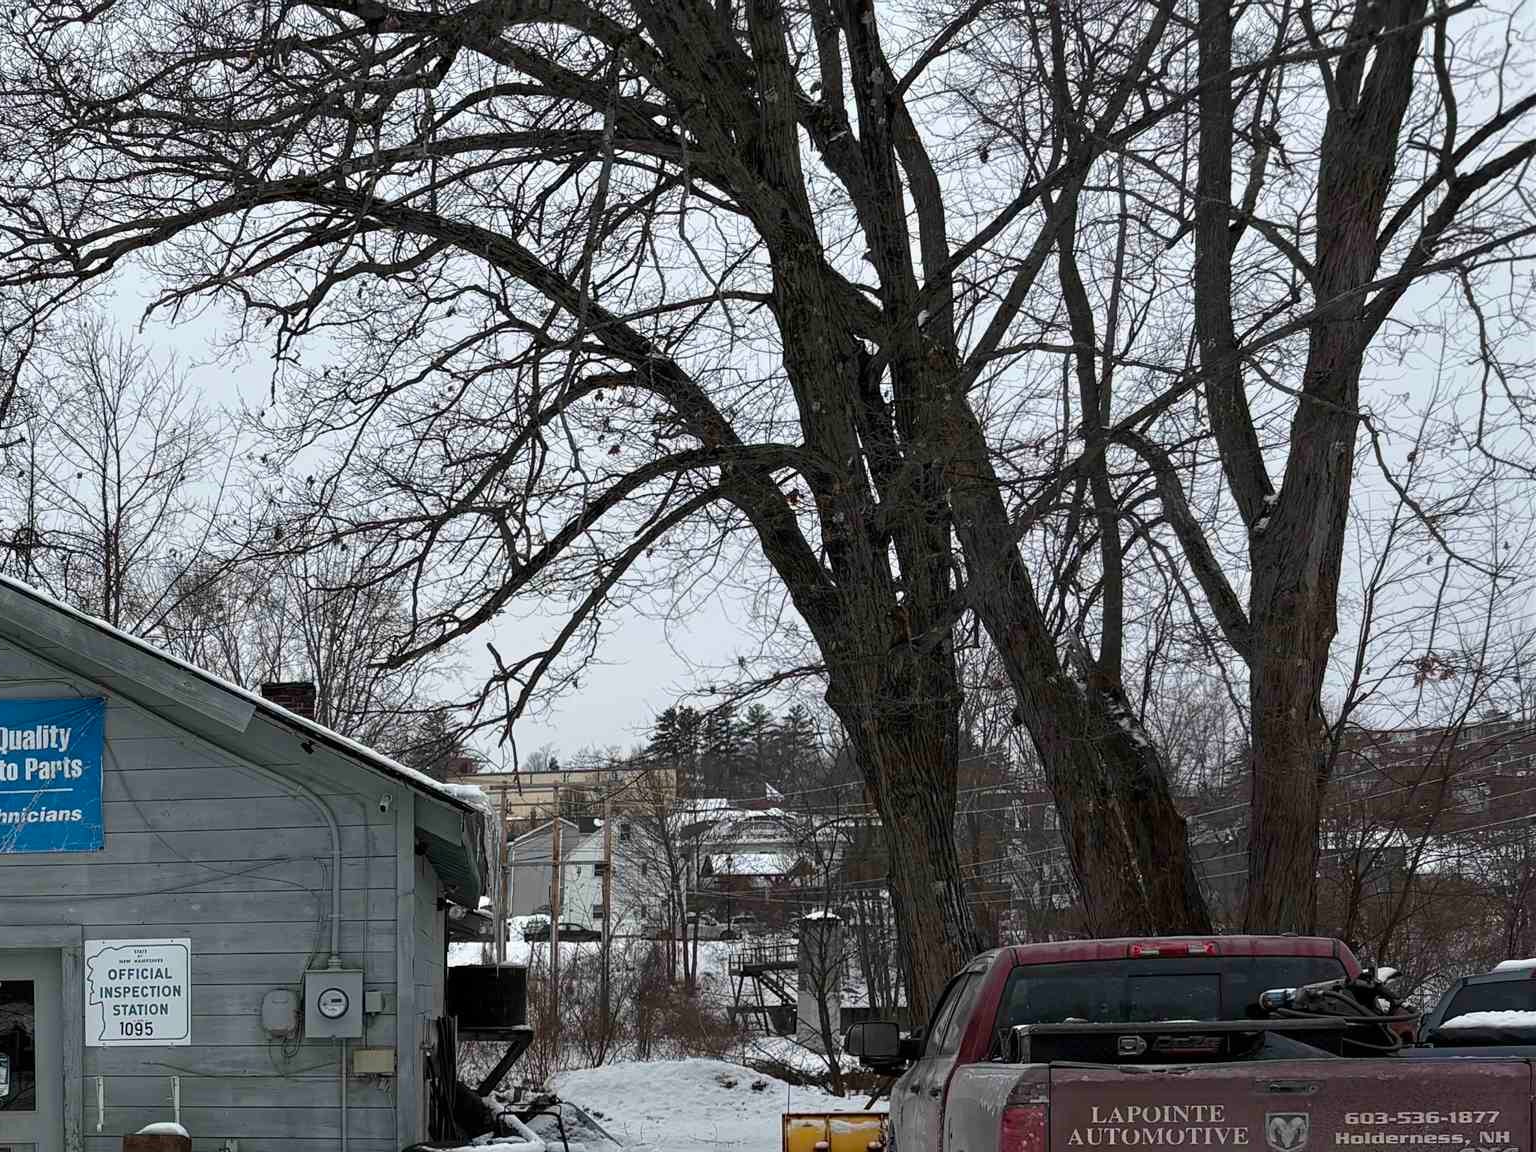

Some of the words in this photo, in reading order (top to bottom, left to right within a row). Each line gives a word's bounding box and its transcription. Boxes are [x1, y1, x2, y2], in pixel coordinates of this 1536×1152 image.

[24, 757, 83, 781] Parts
[107, 967, 173, 981] OFFICIAL
[99, 985, 182, 999] INSPECTION
[112, 1003, 169, 1017] STATION
[119, 1021, 154, 1037] 1095
[1091, 1104, 1225, 1124] LAPOINTE
[1344, 1111, 1500, 1125] 603-536-1877
[1068, 1127, 1249, 1146] AUTOMOTIVE
[1335, 1132, 1471, 1146] Holderness,
[1479, 1131, 1511, 1144] NH
